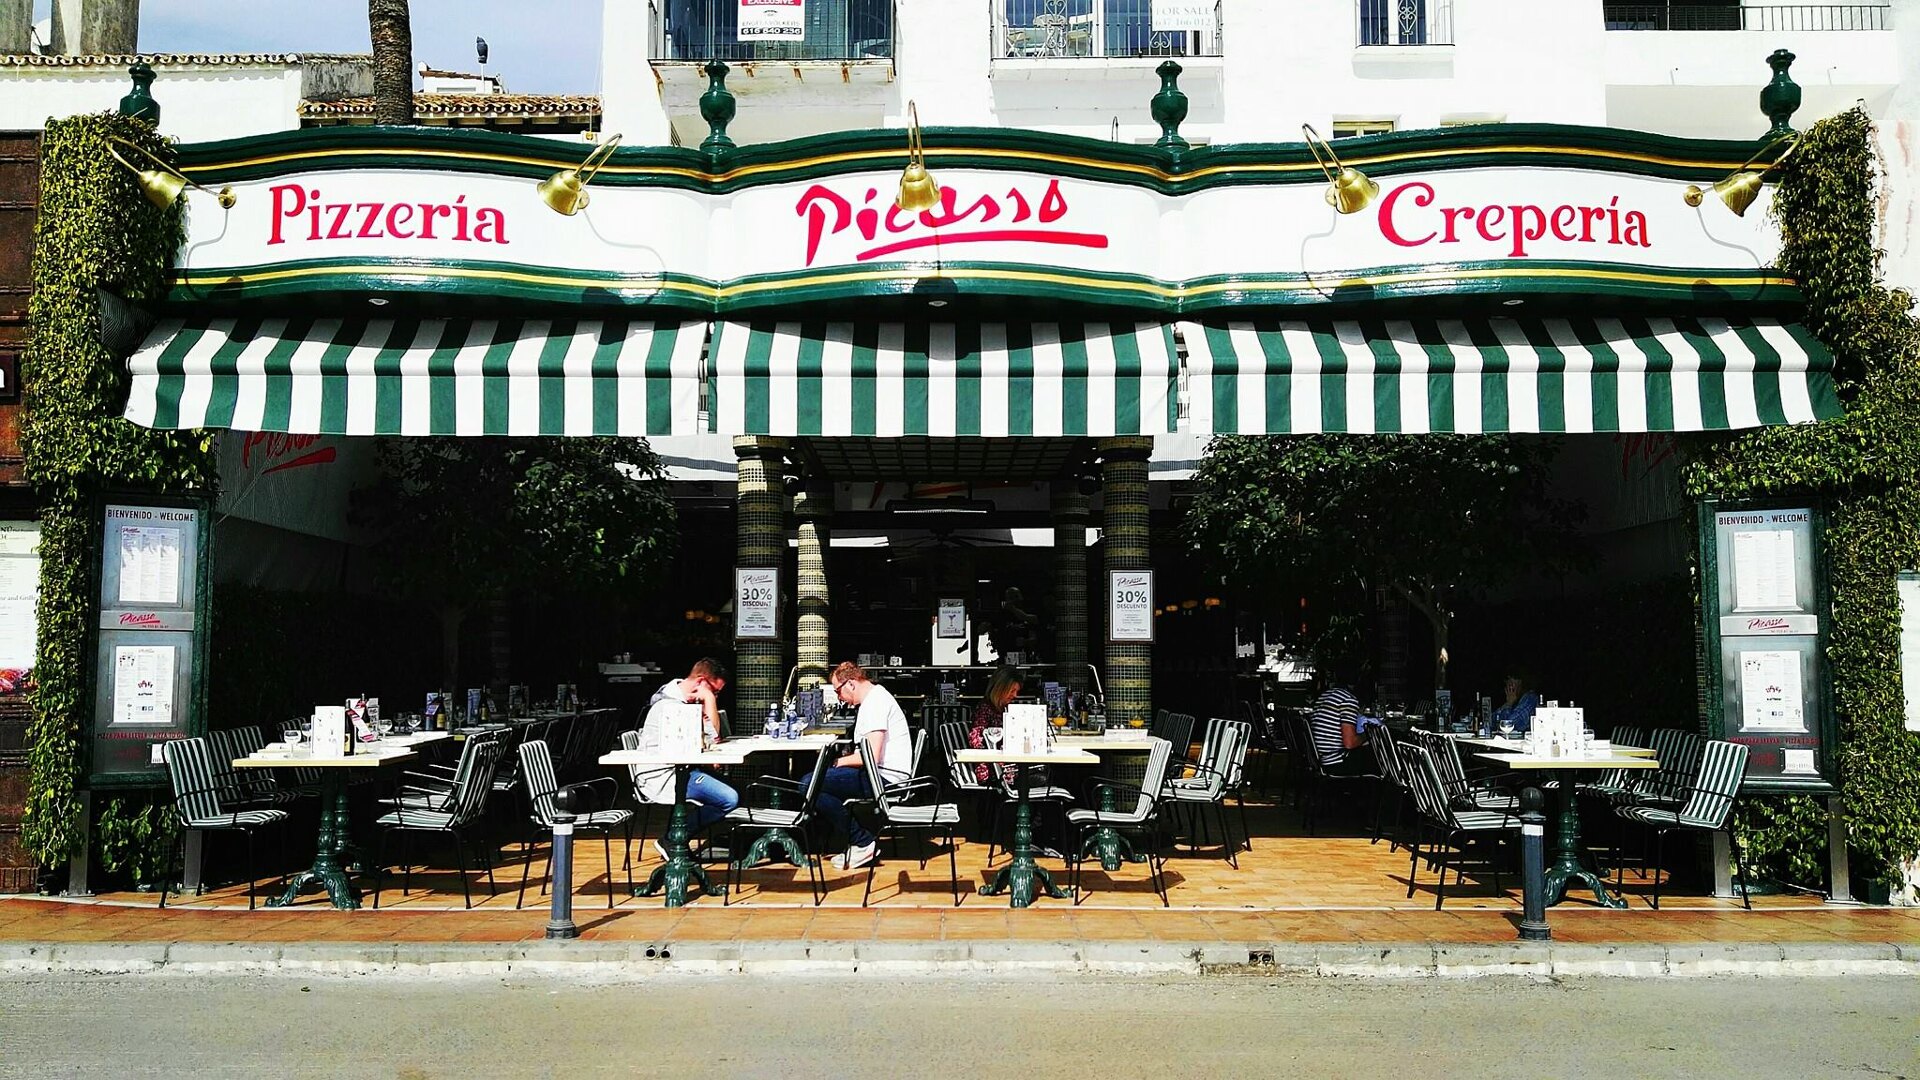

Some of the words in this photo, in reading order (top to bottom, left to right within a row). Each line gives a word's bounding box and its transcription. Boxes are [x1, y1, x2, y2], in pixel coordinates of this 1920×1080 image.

[1156, 7, 1180, 15] FOR
[1184, 7, 1211, 15] SALE
[266, 183, 510, 245] Pizzería
[1377, 181, 1652, 257] Crepería
[796, 180, 1069, 267] Picasso
[107, 509, 152, 520] BIENVENIDO
[159, 511, 194, 522] WELCOME
[1718, 515, 1764, 526] BIENVENIDO
[1771, 513, 1808, 523] WELCOME
[742, 588, 773, 600] 30%
[1117, 591, 1147, 603] 30%
[119, 612, 157, 625] Picasso
[1747, 618, 1785, 630] Picasso
